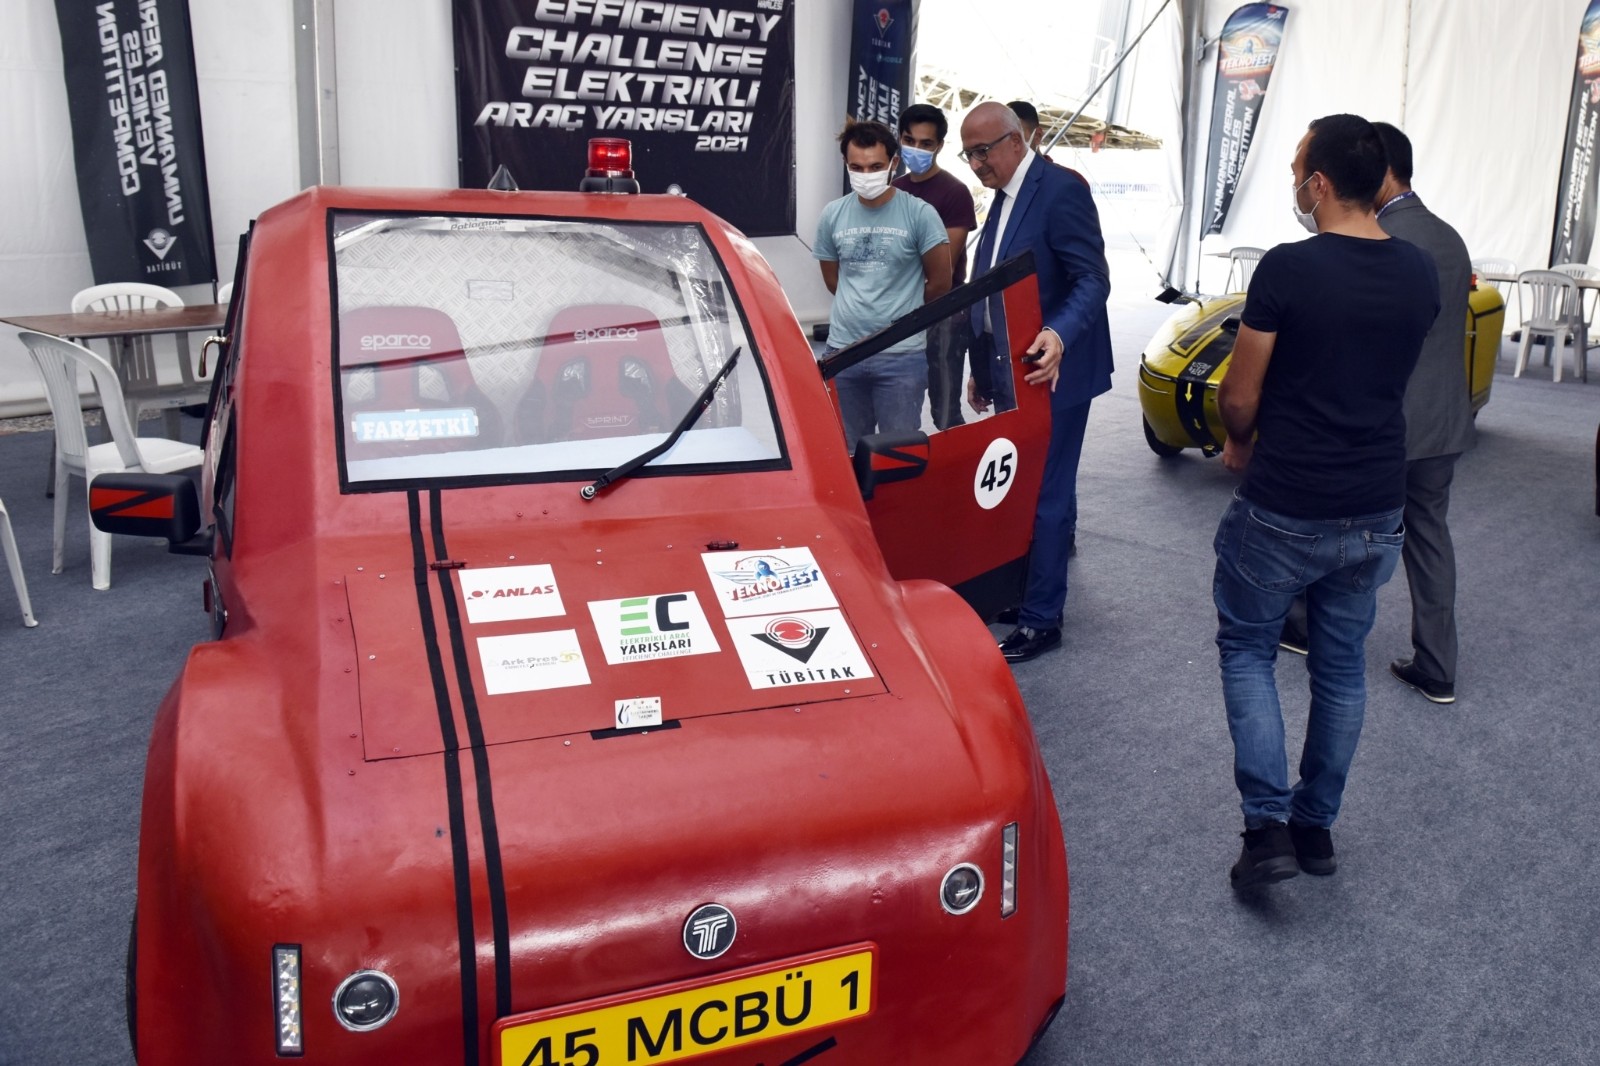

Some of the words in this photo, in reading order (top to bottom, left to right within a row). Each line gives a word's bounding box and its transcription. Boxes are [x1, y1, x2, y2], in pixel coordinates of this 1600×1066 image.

[534, 0, 782, 41] EFFICIENCY
[505, 26, 767, 75] CHALLENGE
[473, 101, 586, 131] ARAÇ
[592, 105, 754, 133] YARIŞLARI
[694, 135, 749, 152] 2021
[1214, 137, 1230, 213] UNMANNED
[1223, 88, 1237, 137] AERIAL
[1226, 118, 1242, 185] VEHICLES
[859, 226, 872, 234] FOR
[873, 226, 908, 237] ADVENTURE
[360, 334, 431, 351] sparco
[574, 327, 638, 344] sparco
[362, 413, 472, 440] FARZETKİ
[586, 415, 630, 425] SPRINT
[980, 452, 1012, 492] 45
[493, 584, 555, 598] ANLAS
[726, 569, 819, 601] TEKNOFEST
[620, 638, 692, 655] YARIŞLARI
[657, 648, 692, 658] CHALLENGE
[501, 658, 525, 666] Ark
[766, 666, 855, 685] TÜBİTAK
[520, 1027, 600, 1066] 45
[626, 971, 813, 1062] MCBÜ
[840, 970, 860, 1011] 1
